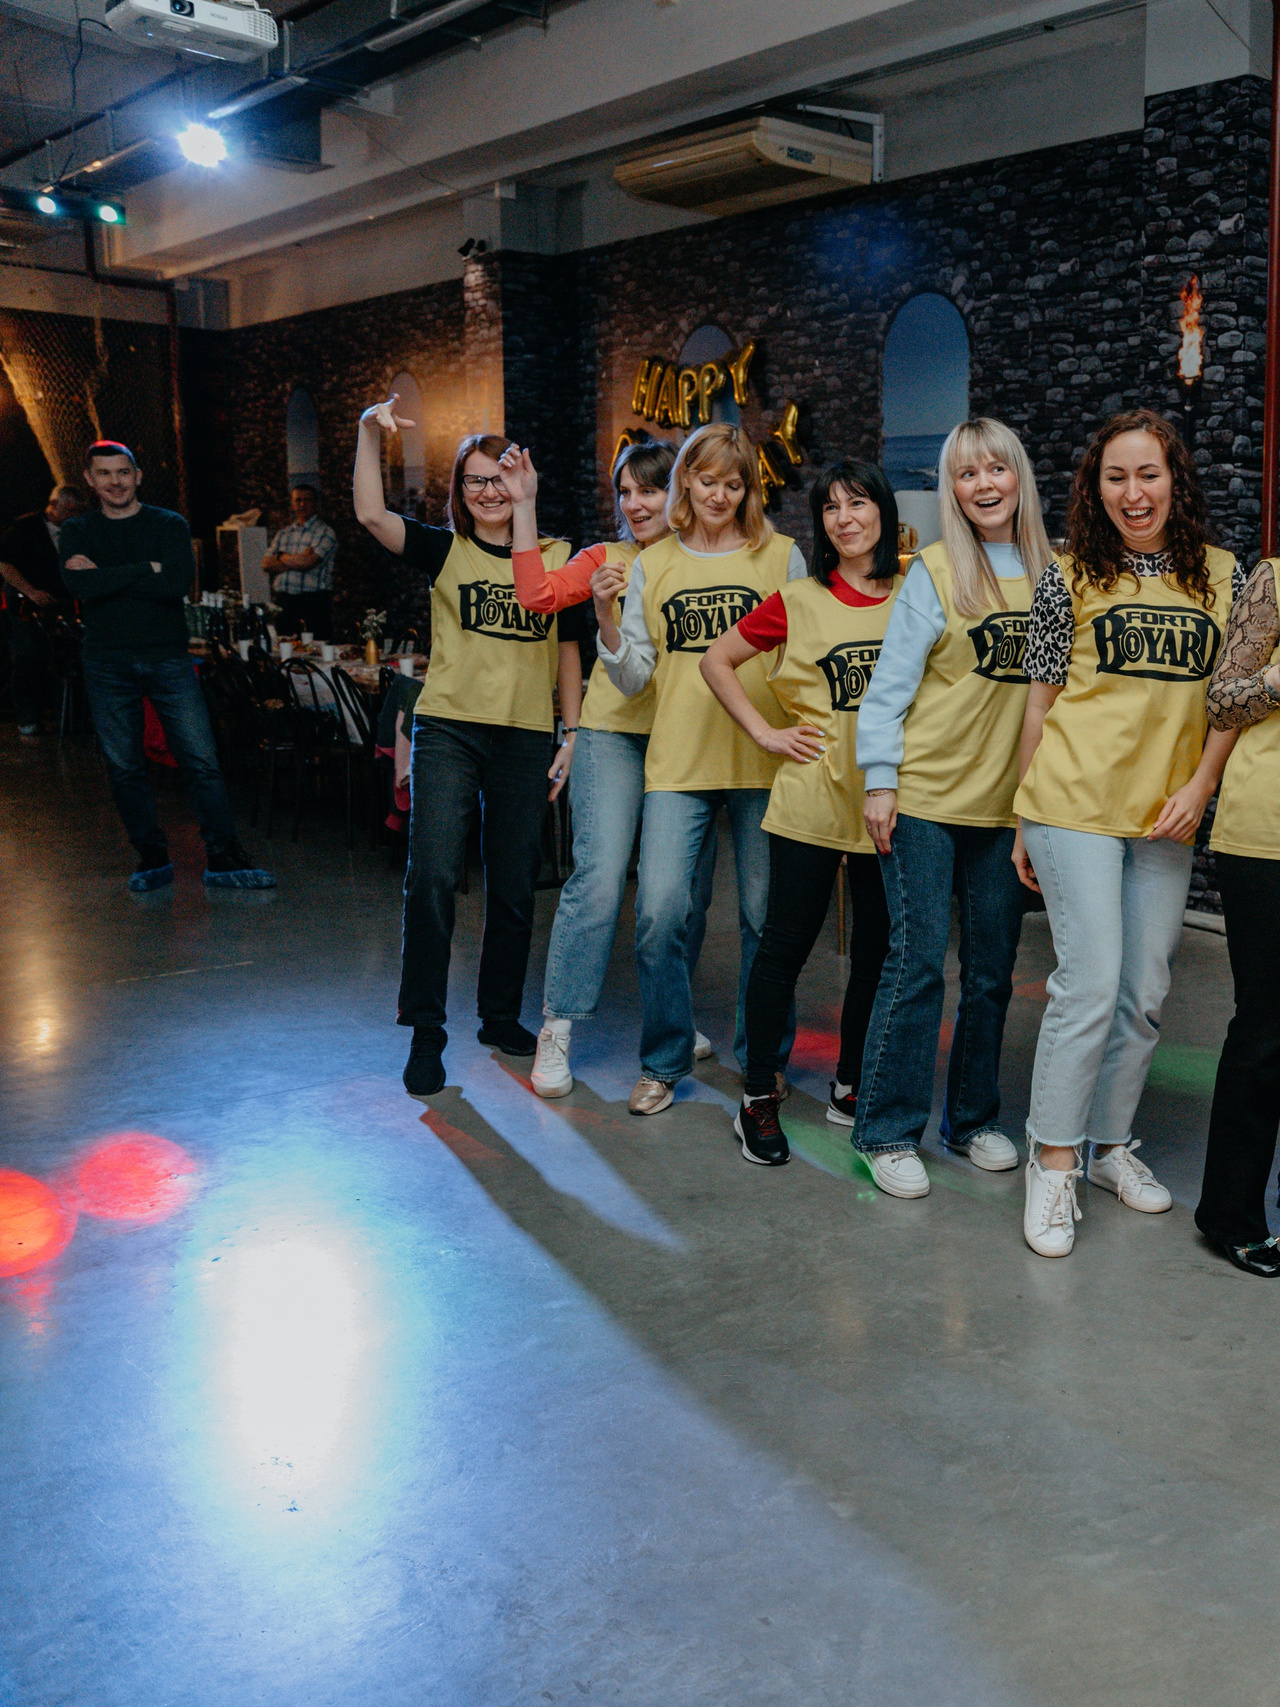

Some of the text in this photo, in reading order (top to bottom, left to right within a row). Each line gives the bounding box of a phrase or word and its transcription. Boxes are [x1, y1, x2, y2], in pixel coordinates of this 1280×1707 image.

[631, 340, 756, 430] HAPPY
[685, 592, 739, 607] FORT
[1126, 611, 1192, 628] FORT
[1091, 612, 1221, 677] BOYARD
